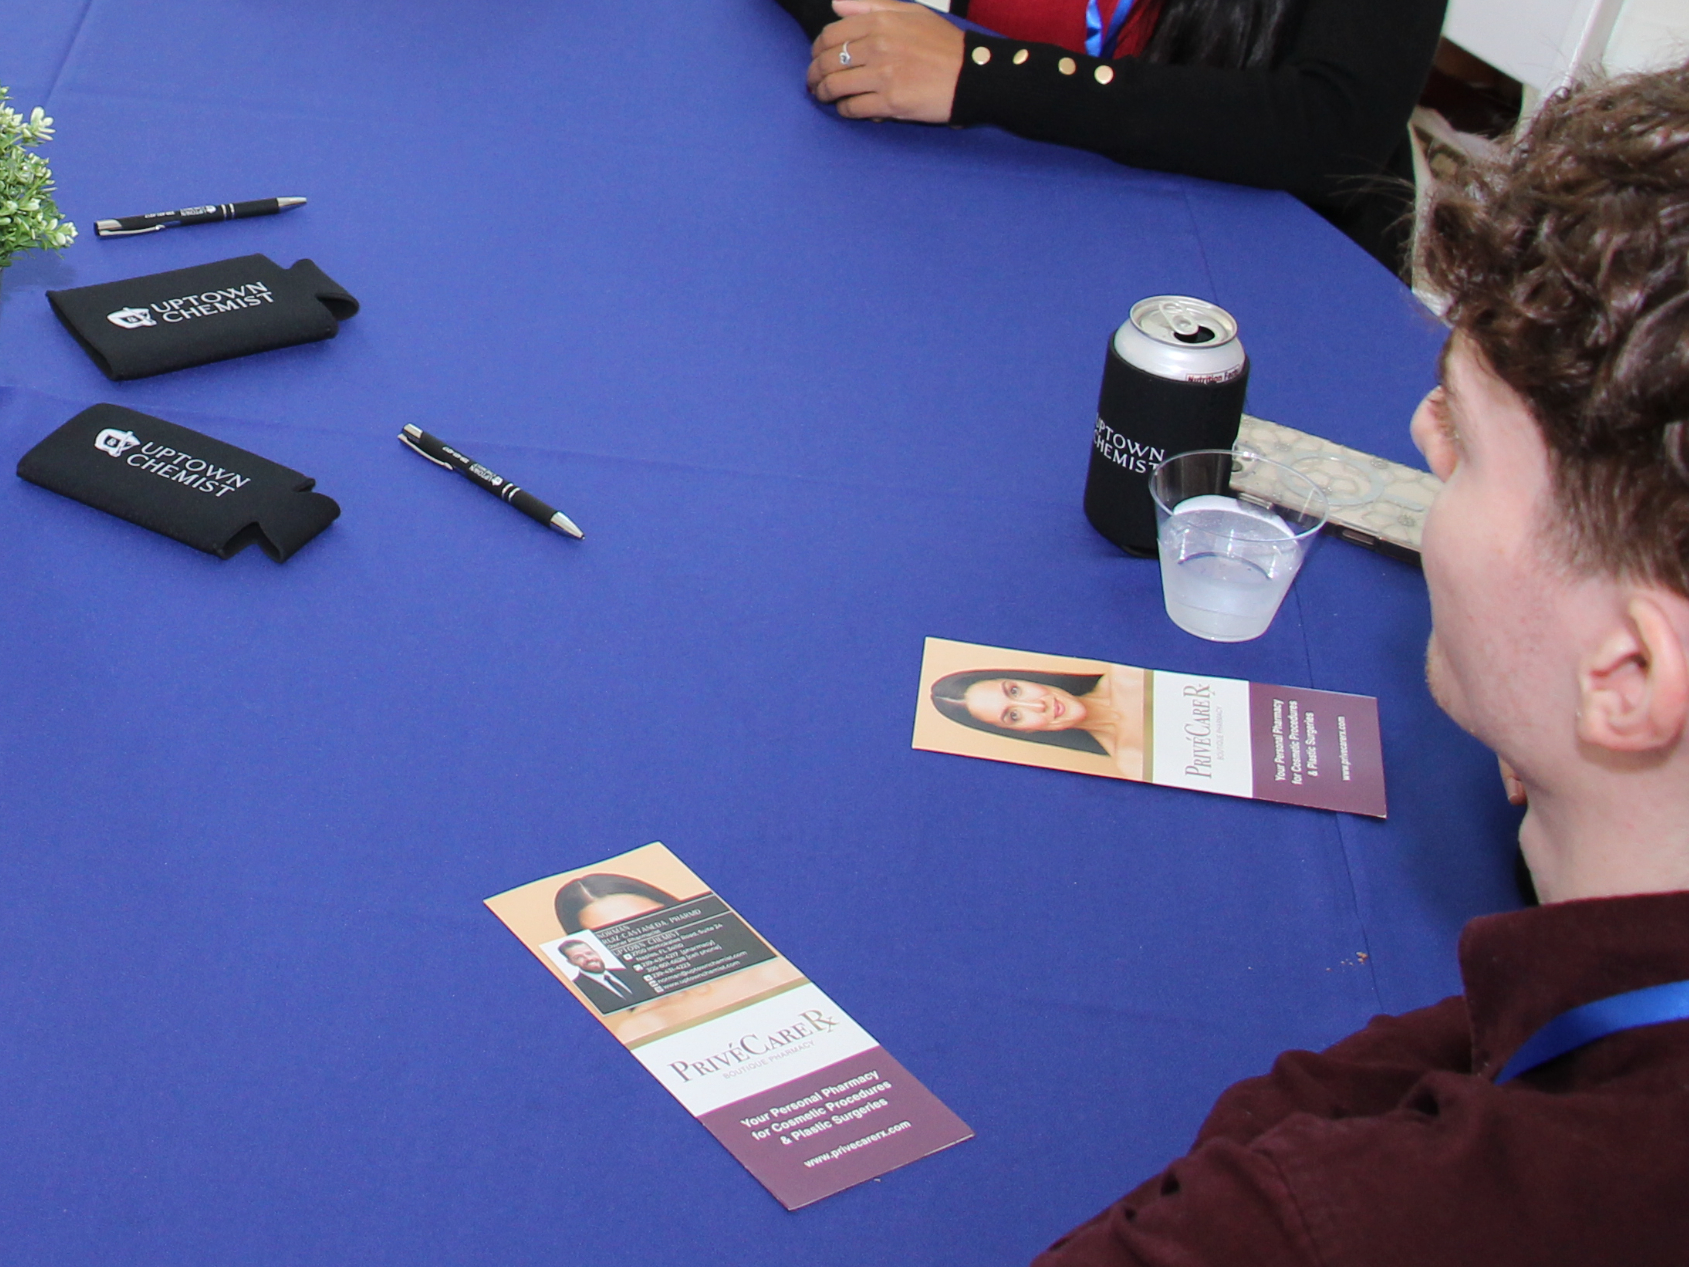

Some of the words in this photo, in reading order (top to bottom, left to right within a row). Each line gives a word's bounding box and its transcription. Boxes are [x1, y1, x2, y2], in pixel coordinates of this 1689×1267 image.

[150, 281, 269, 315] UPTOWN
[161, 292, 275, 323] CHEMIST
[126, 453, 236, 498] CHEMIST
[141, 441, 251, 490] UPTOWN
[1272, 699, 1284, 734] Pharmacy
[1273, 735, 1286, 764] Personal
[1274, 765, 1286, 781] Your
[722, 1059, 768, 1080] BOUTIQUE
[768, 1040, 815, 1062] PHARMACY
[739, 1114, 770, 1130] Your
[770, 1092, 822, 1118] Personal
[821, 1069, 880, 1099] Pharmacy
[751, 1128, 771, 1142] for
[771, 1107, 827, 1134] Cosmetic
[825, 1080, 892, 1112] Procedures
[779, 1135, 792, 1146] &
[791, 1121, 833, 1142] Plastic
[831, 1097, 889, 1126] Surgeries
[803, 1119, 912, 1169] www.privecarerx.com
